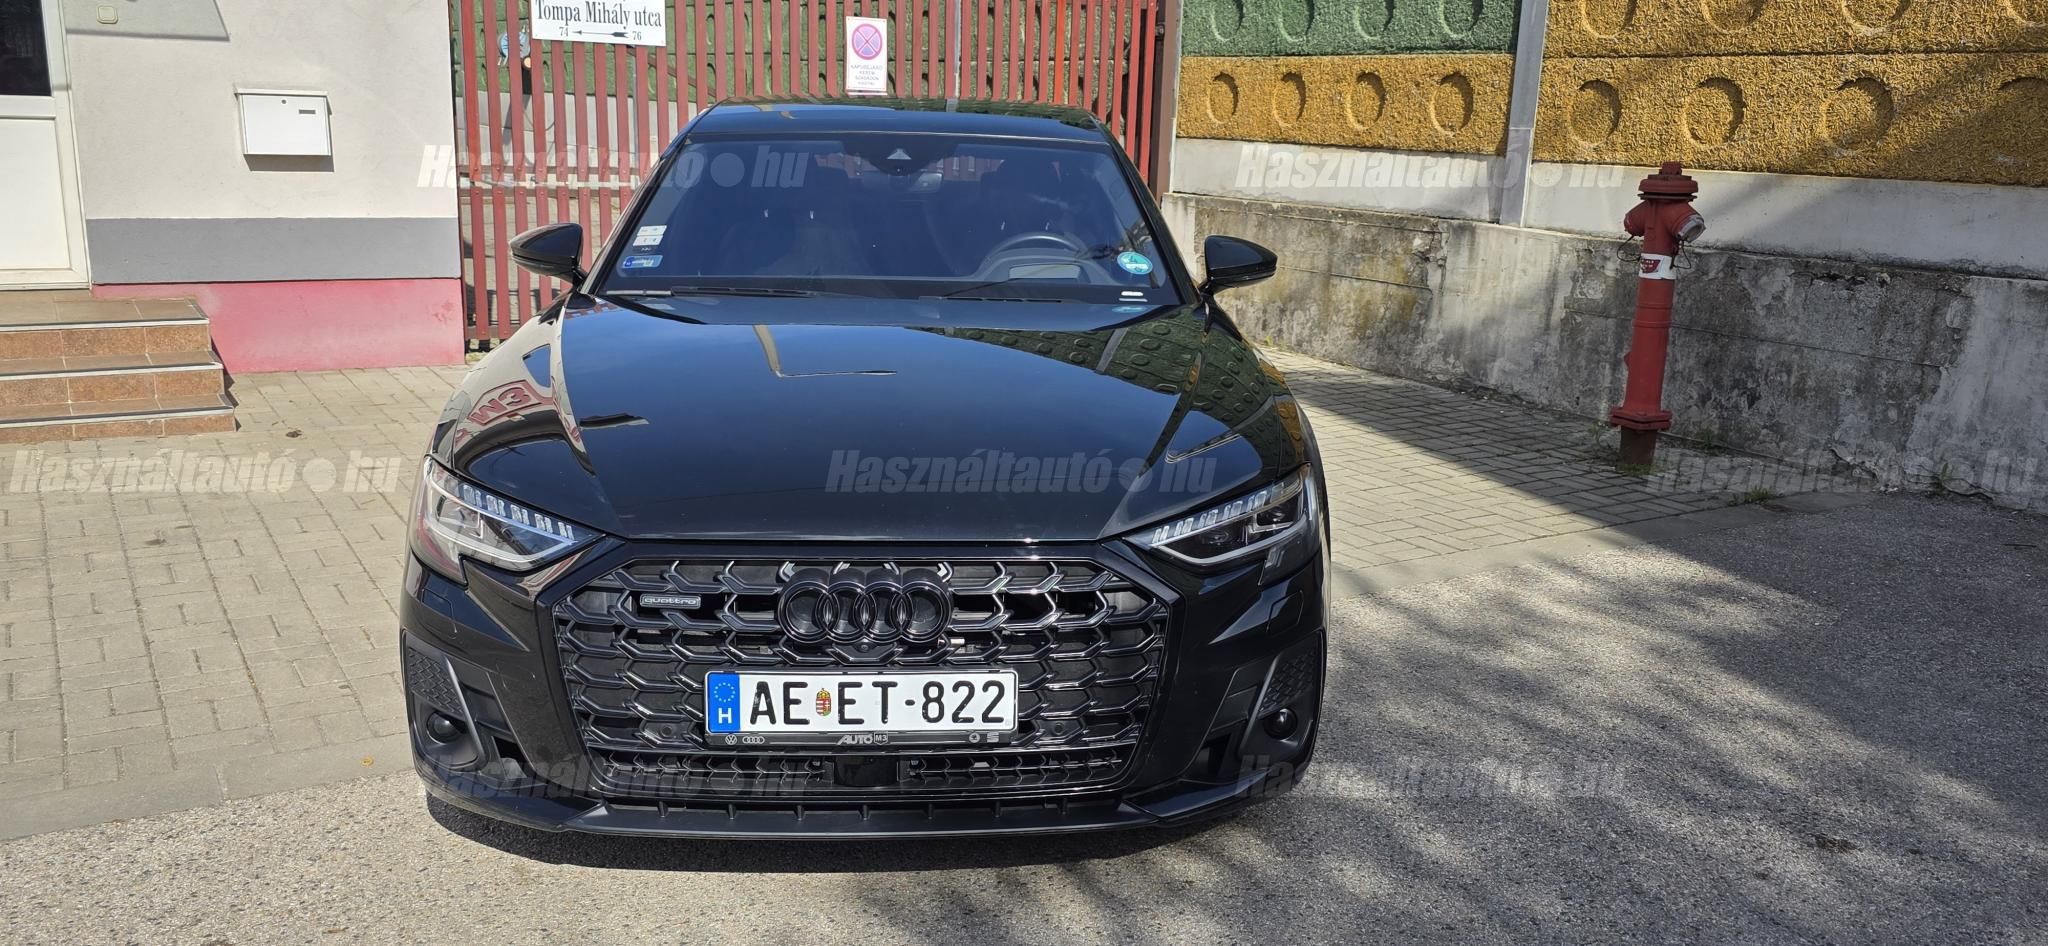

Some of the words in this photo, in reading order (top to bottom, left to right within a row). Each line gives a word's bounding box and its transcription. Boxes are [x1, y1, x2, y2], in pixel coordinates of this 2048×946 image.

[536, 0, 581, 26] Tompa
[585, 0, 630, 29] Mihály
[635, 6, 662, 27] utca
[559, 26, 569, 37] 74
[632, 31, 642, 41] 76
[643, 597, 697, 606] quattro
[750, 681, 810, 725] AE
[718, 708, 732, 724] H
